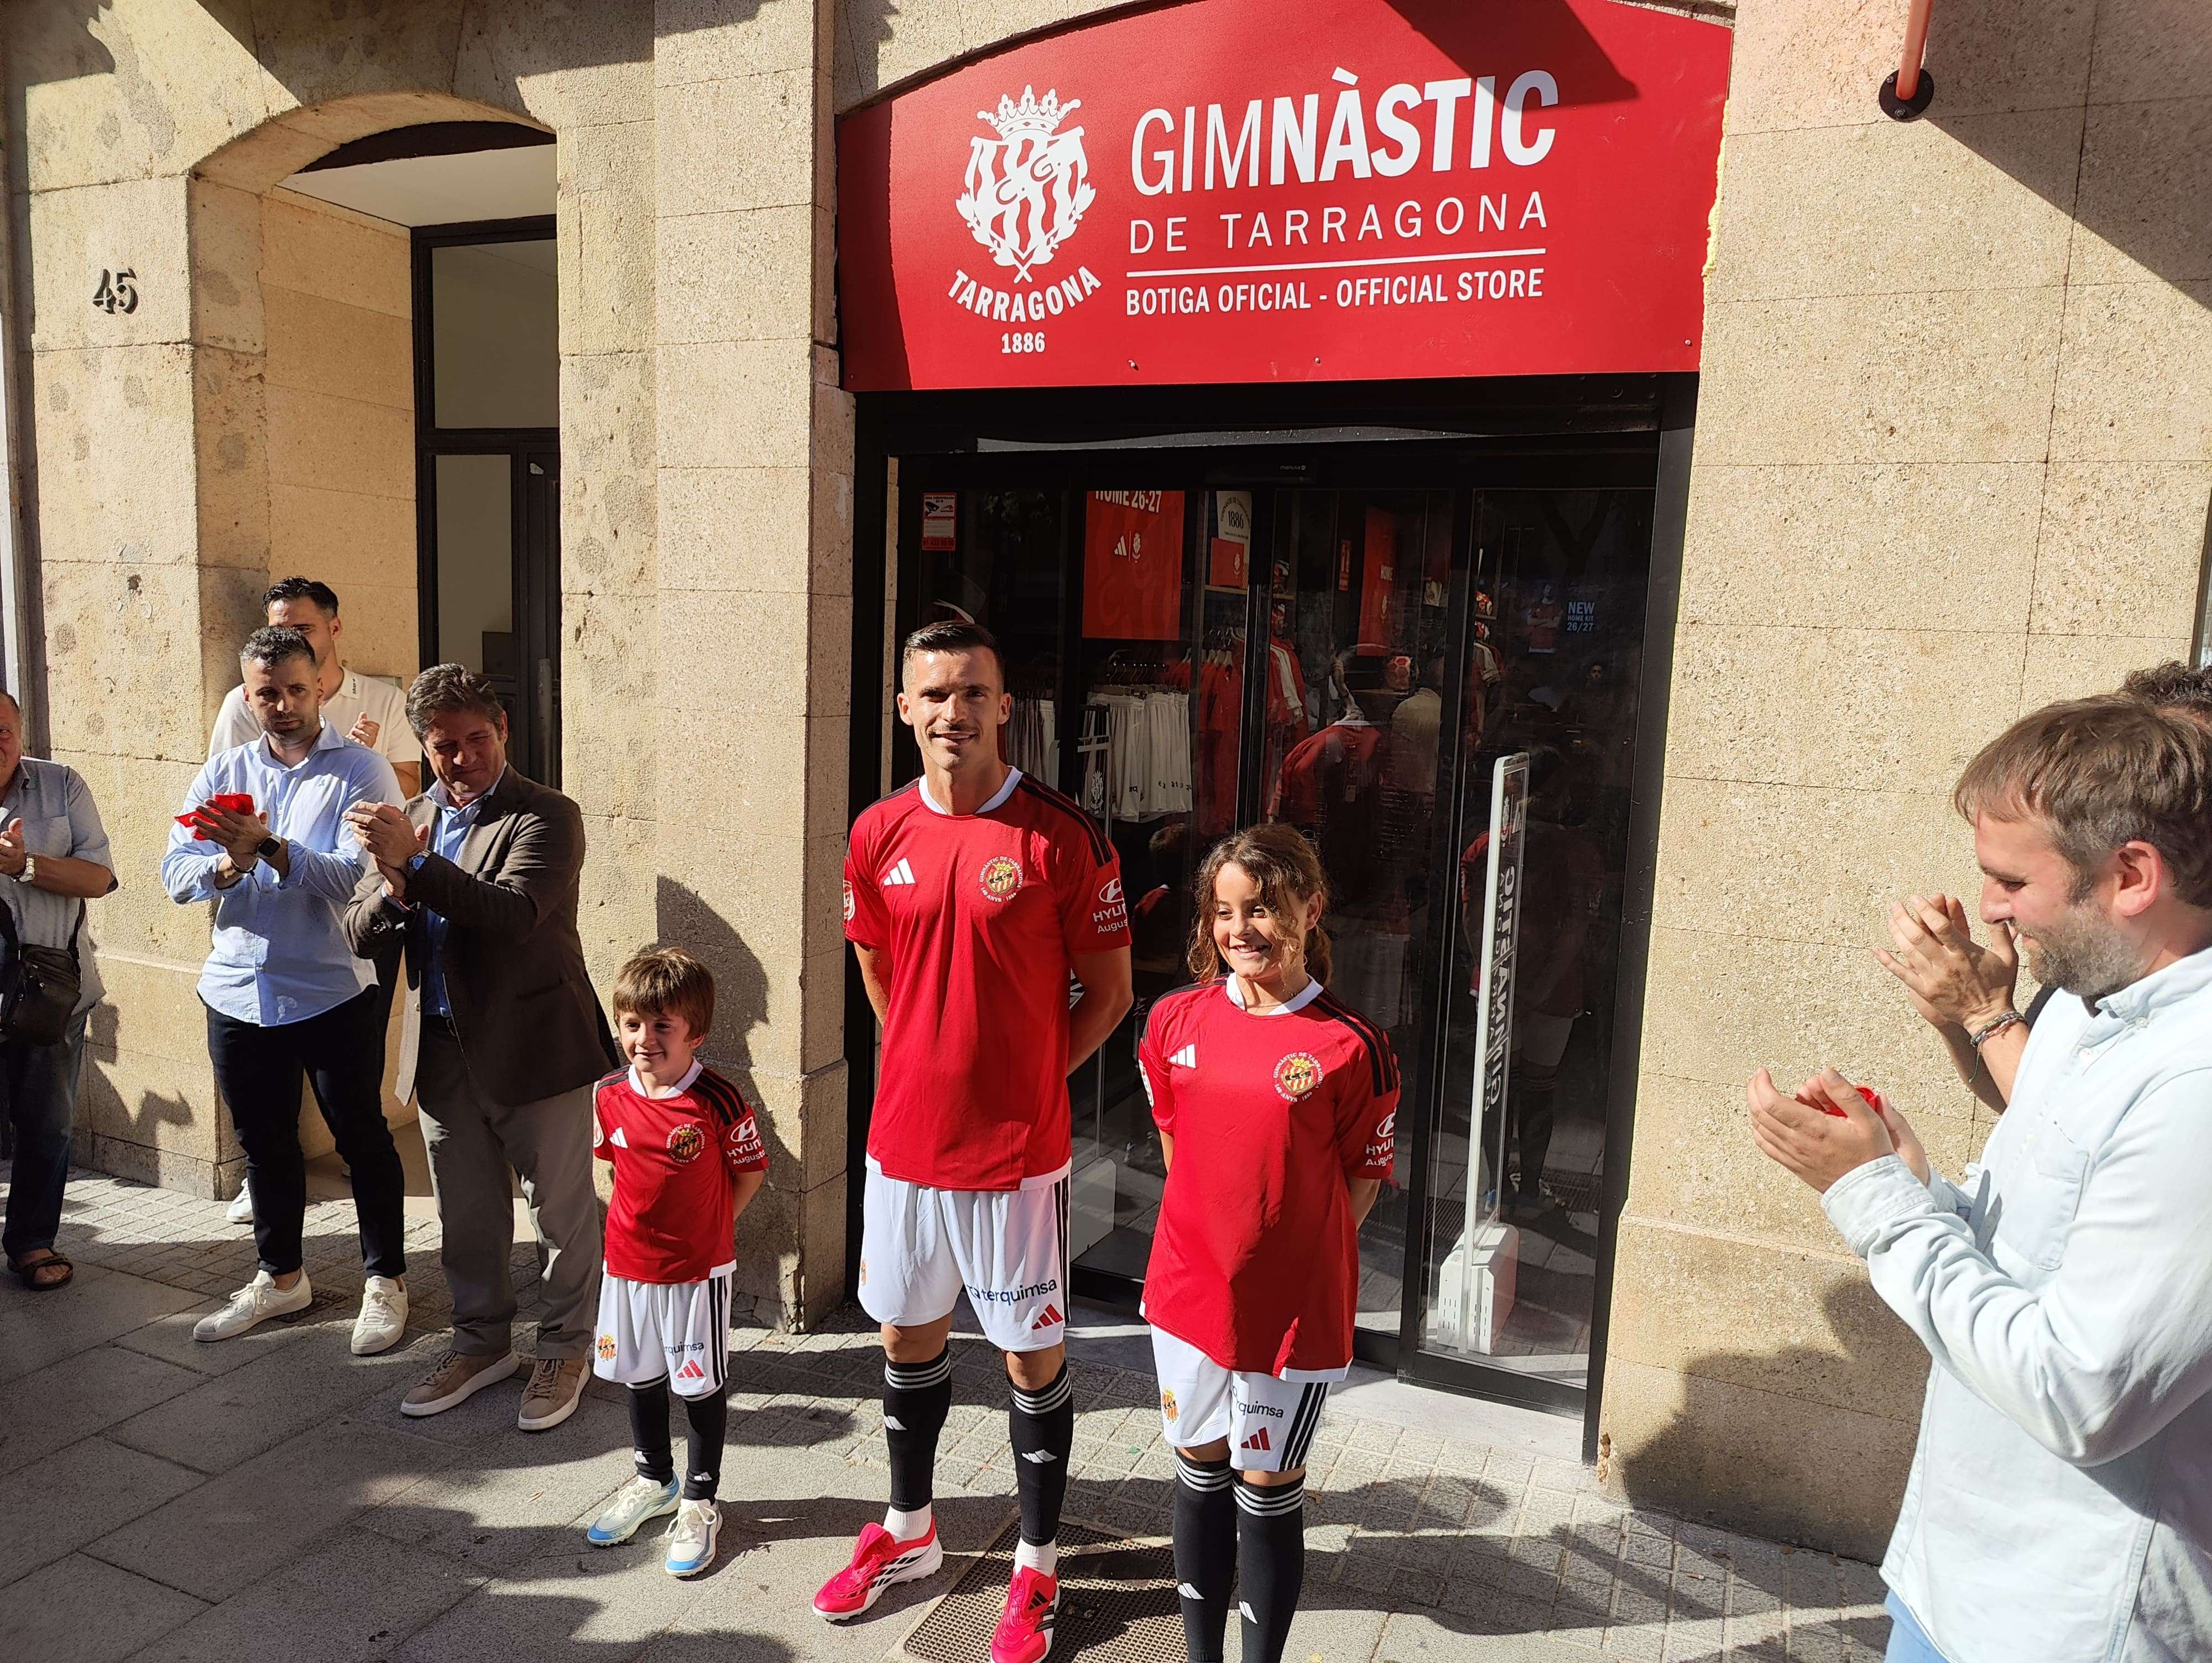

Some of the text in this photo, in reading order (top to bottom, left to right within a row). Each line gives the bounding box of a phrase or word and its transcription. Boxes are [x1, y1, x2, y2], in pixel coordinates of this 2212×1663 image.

[1131, 66, 1558, 196] GIMNÀSTIC
[1130, 191, 1547, 254] DE TARRAGONA
[92, 268, 138, 314] 45
[948, 265, 1102, 322] TARRAGONA
[1126, 286, 1210, 316] BOTIGA
[1218, 279, 1311, 312] OFICIAL
[1336, 274, 1448, 307] OFFICIAL
[1457, 268, 1545, 301] STORE
[1001, 332, 1045, 354] 1886
[1228, 511, 1244, 530] 1886
[1568, 602, 1595, 614] NEW
[1567, 622, 1594, 634] 26/27
[1008, 857, 1023, 888] TARRAGONA
[980, 1279, 1057, 1306] terquimsa
